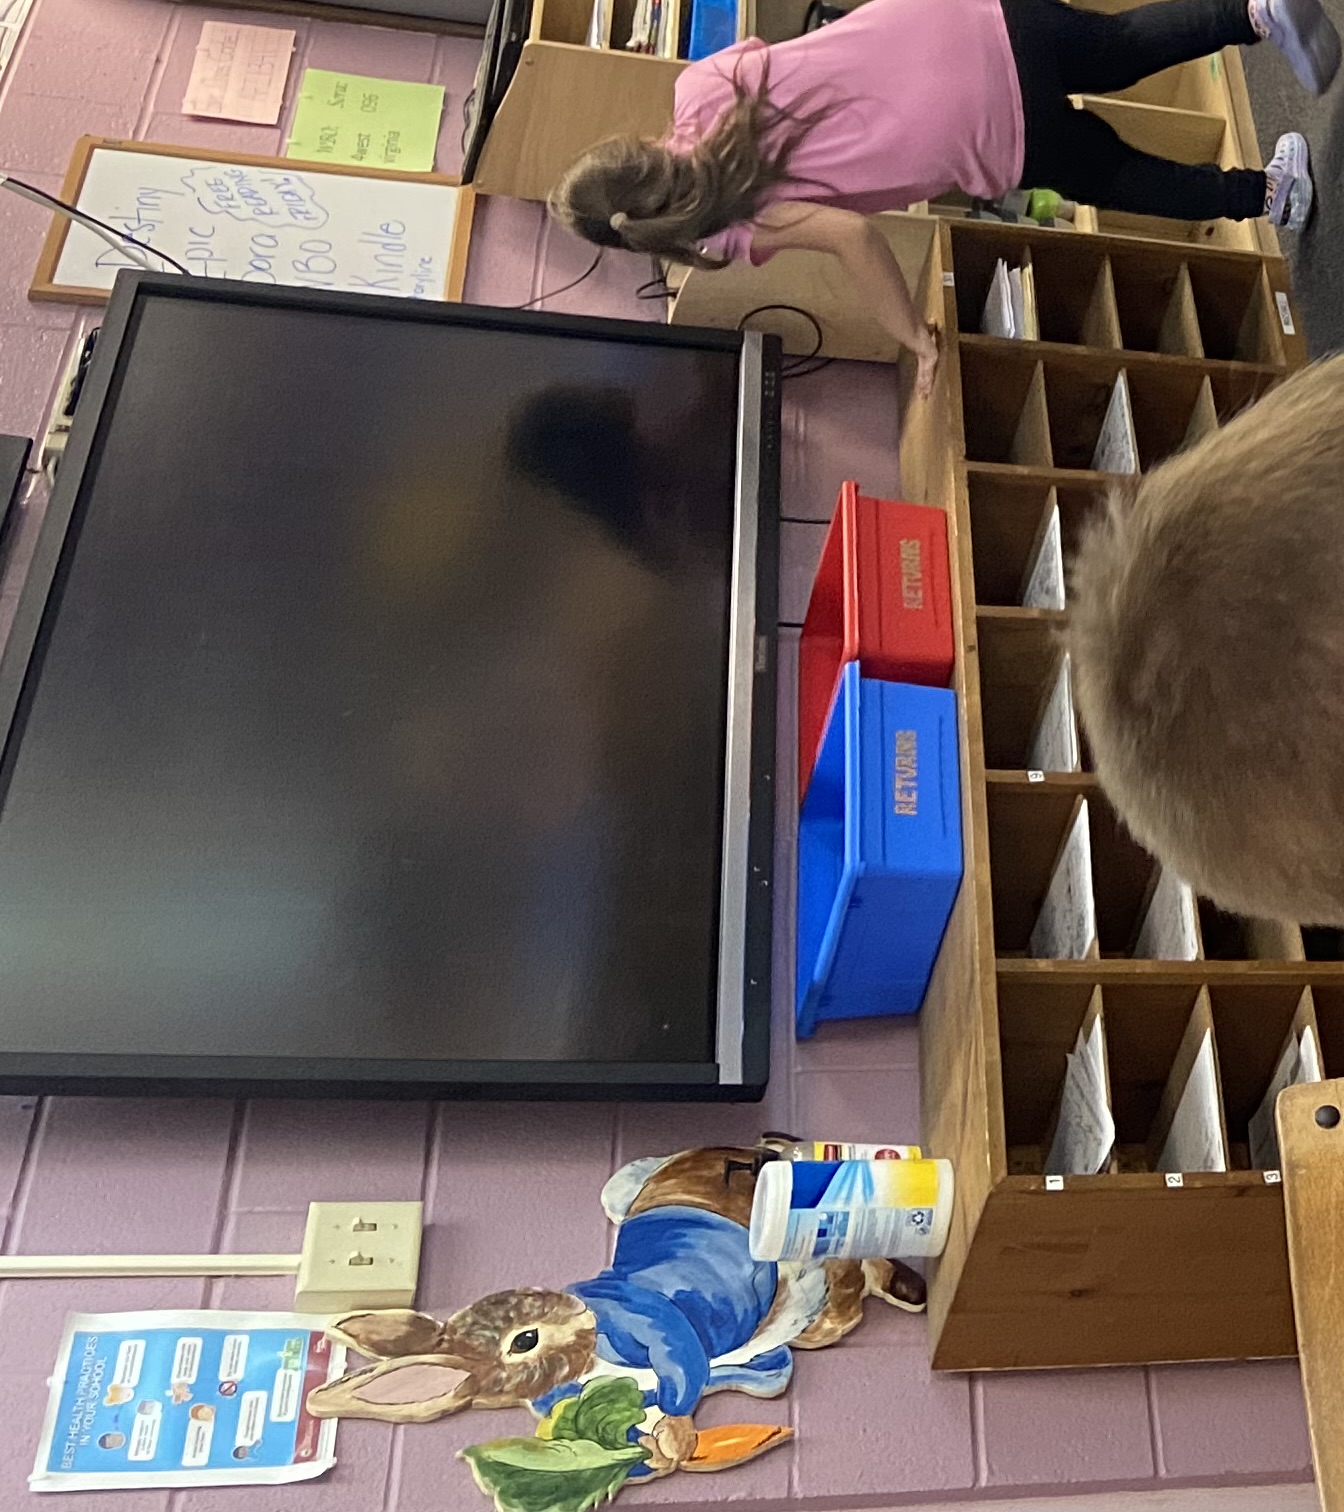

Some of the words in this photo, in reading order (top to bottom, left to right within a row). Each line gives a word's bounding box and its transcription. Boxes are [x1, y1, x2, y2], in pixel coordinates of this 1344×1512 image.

[204, 177, 240, 209] FREE
[225, 169, 279, 215] READING
[95, 187, 185, 268] Destiny
[349, 219, 407, 291] Kindle
[899, 538, 923, 610] RETURNS
[894, 729, 919, 815] RETURNS
[1167, 1175, 1181, 1184] 2
[1265, 1172, 1279, 1181] 3
[77, 1336, 98, 1395] PRACTICES
[89, 1356, 108, 1399] SCHOOL
[67, 1397, 86, 1439] HEALTH
[81, 1402, 96, 1432] YOUR
[61, 1441, 75, 1469] BEST
[79, 1435, 91, 1446] IN
